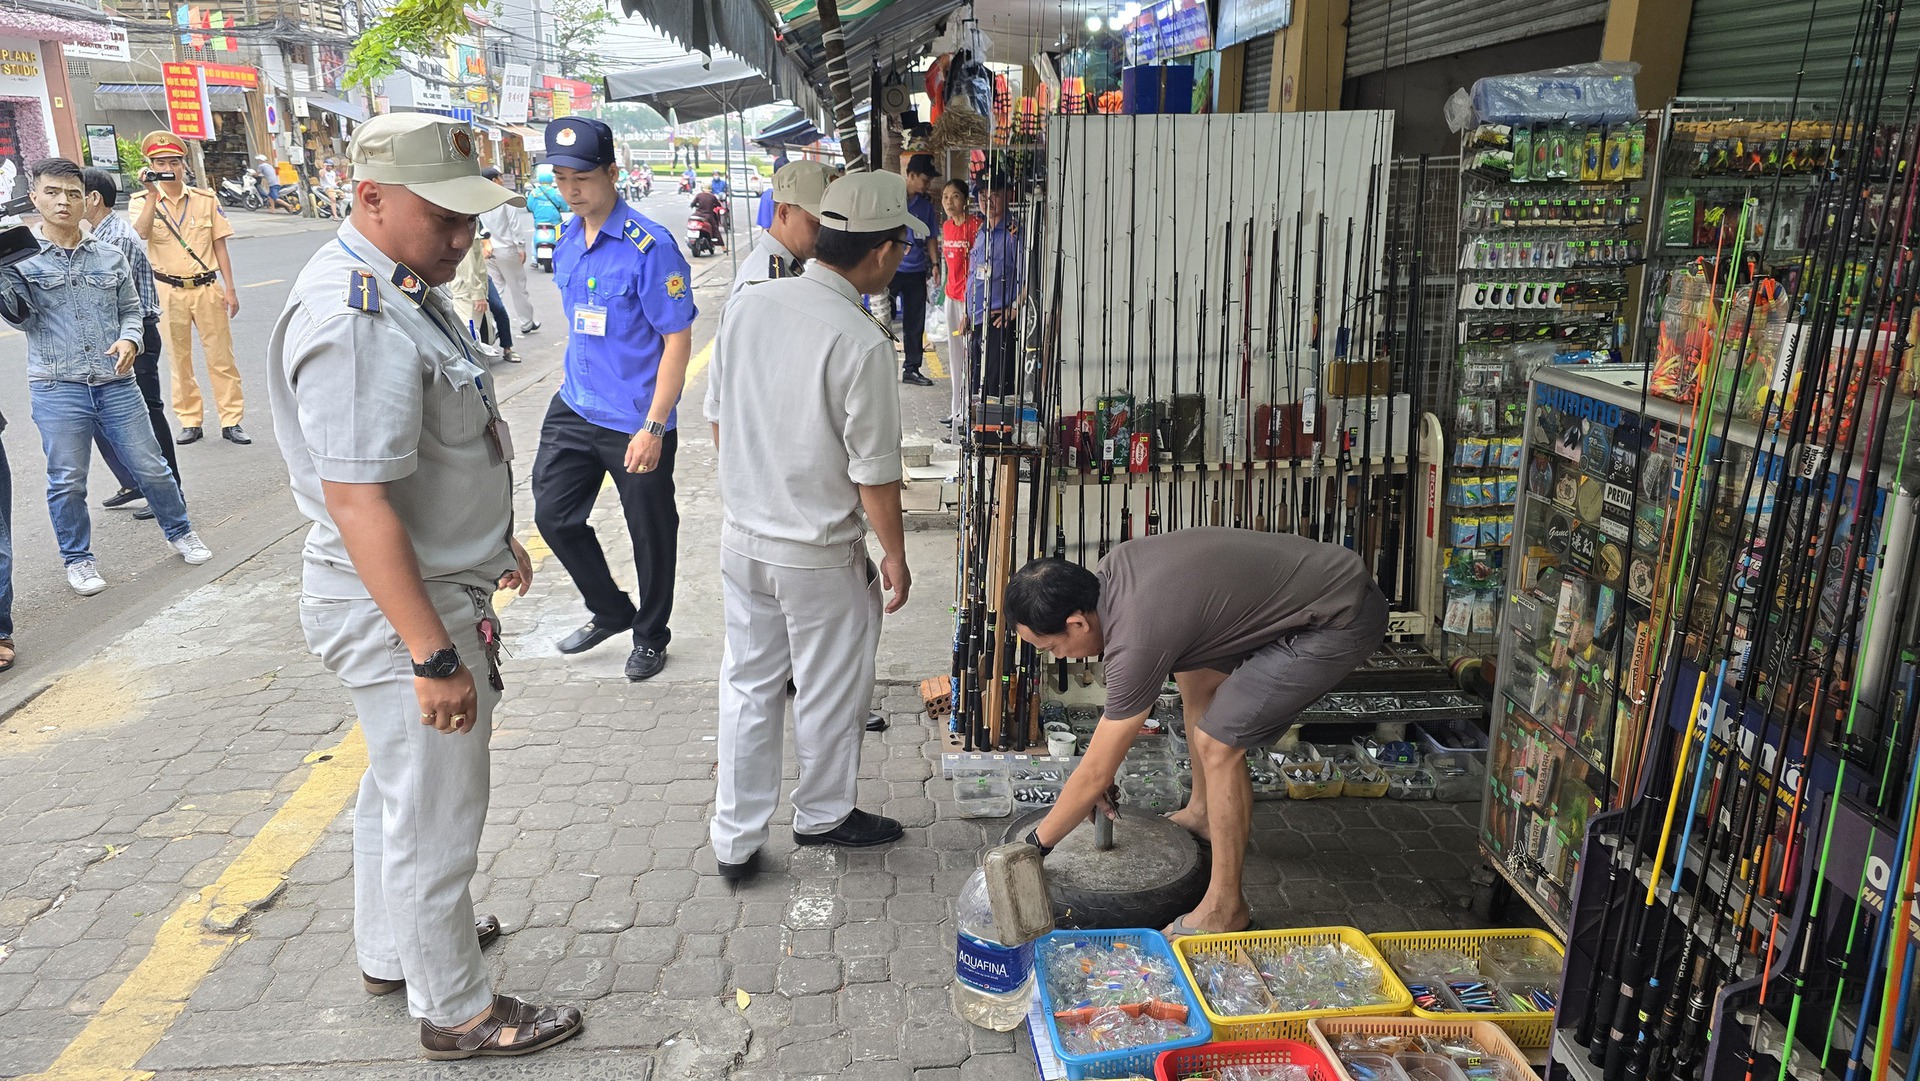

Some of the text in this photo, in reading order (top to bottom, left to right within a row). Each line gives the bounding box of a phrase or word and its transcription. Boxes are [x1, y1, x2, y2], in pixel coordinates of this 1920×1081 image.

[3, 63, 39, 77] STUDIO
[1535, 383, 1621, 429] SHIMANO
[1802, 446, 1811, 464] Abu
[1804, 448, 1819, 476] Garcia
[1606, 487, 1632, 507] PREVIA
[1603, 503, 1631, 519] TOTAL
[1548, 526, 1568, 540] Game
[1536, 751, 1550, 804] MEGABARR
[959, 949, 1009, 978] AQUAFINA
